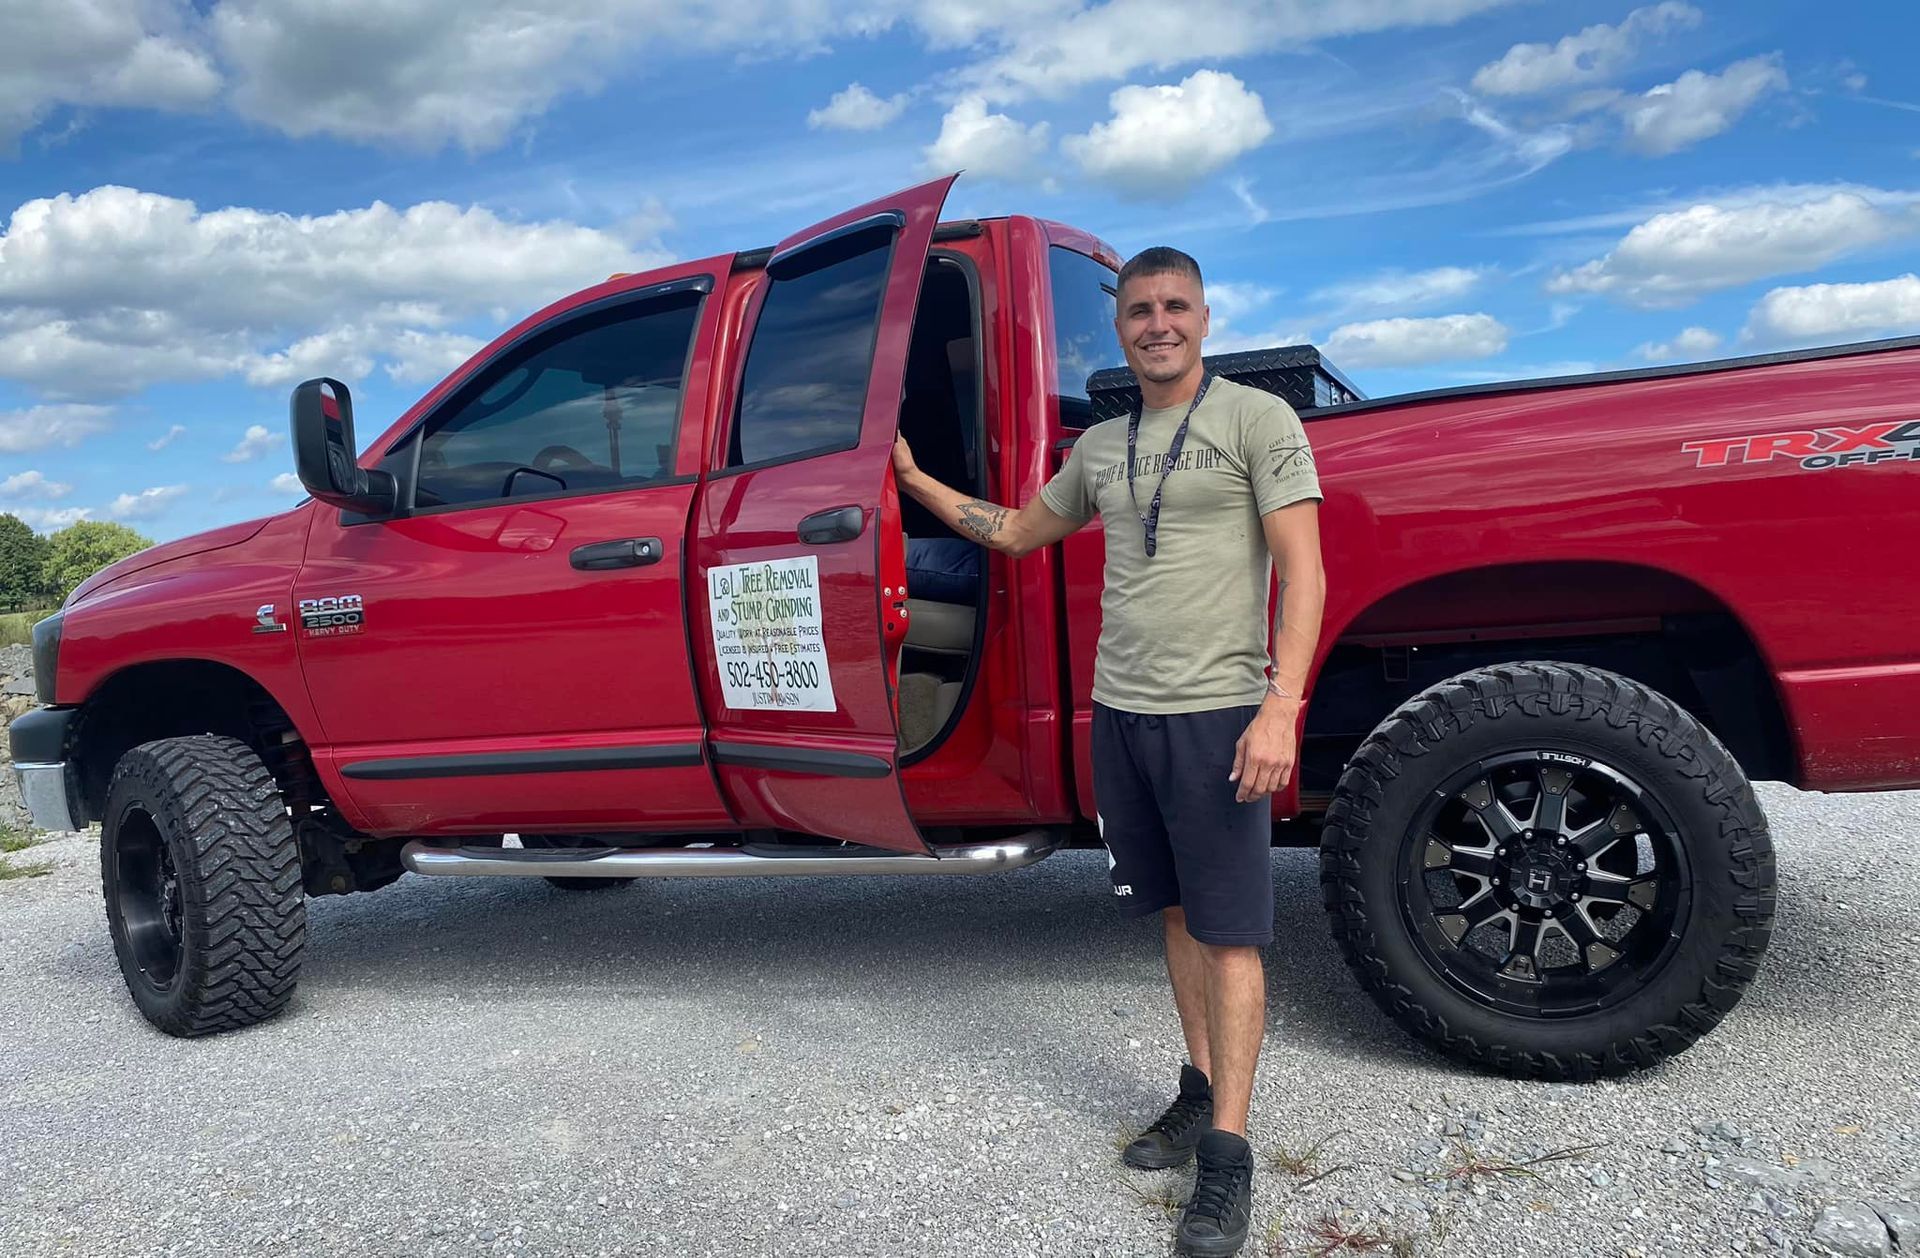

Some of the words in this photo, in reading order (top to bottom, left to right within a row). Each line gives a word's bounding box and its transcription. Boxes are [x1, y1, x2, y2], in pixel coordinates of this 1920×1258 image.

[1117, 461, 1126, 481] A
[1134, 454, 1152, 478] ICE
[1153, 450, 1193, 475] RAGE
[1196, 448, 1222, 470] DAY
[739, 567, 763, 595] TREE
[764, 564, 813, 594] REMOVAL
[299, 594, 363, 616] RAM
[717, 608, 730, 622] AND
[731, 600, 763, 626] STUMP
[765, 596, 813, 622] GRINDING
[306, 613, 360, 628] 2500
[309, 627, 335, 636] HEAVY
[338, 624, 360, 633] DUTY
[716, 629, 736, 641] QUALITY
[761, 626, 798, 639] REASONABLE
[798, 625, 820, 638] PRICES
[774, 643, 789, 655] FREE
[727, 660, 819, 689] 502-450-3800
[1541, 752, 1586, 766] HOSTILE
